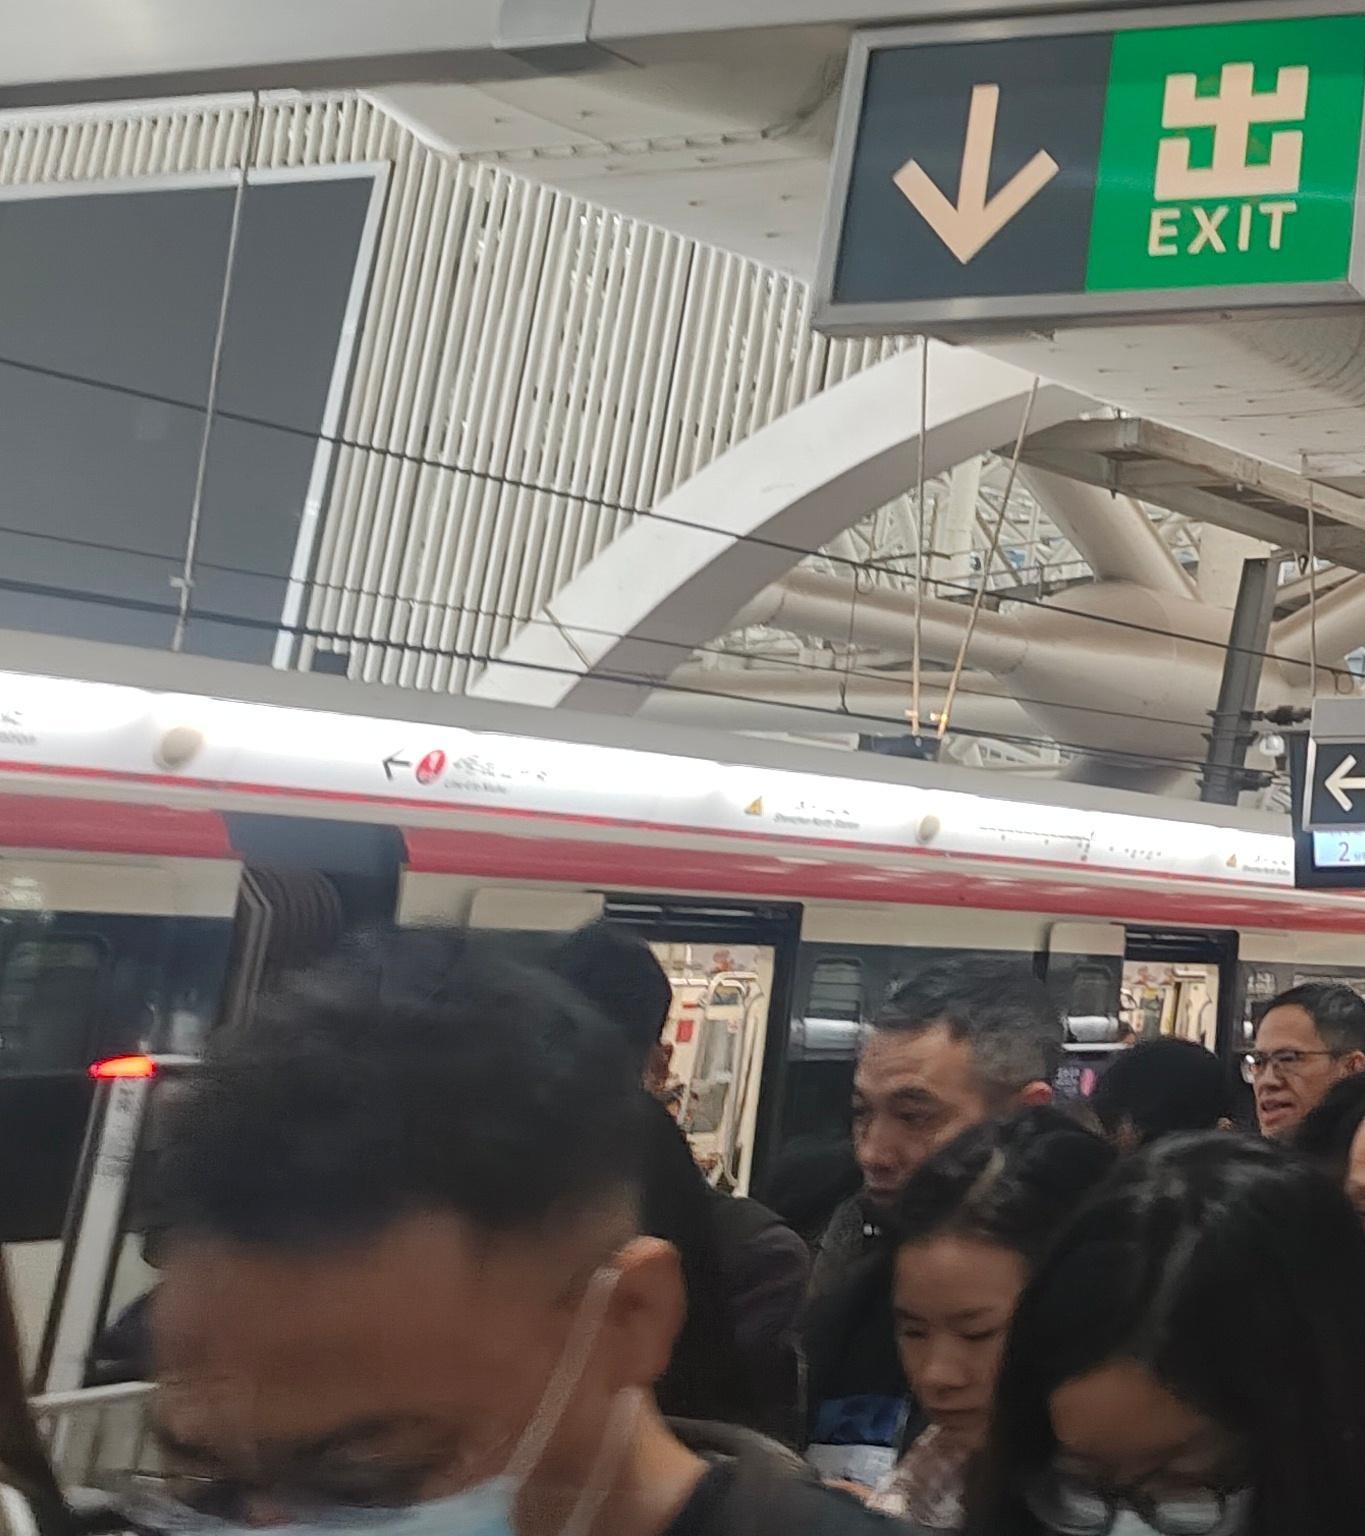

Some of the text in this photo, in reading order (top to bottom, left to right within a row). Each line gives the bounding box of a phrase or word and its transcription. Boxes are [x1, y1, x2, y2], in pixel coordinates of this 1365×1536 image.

[1154, 61, 1310, 202] 出
[1147, 200, 1298, 258] EXIT
[1338, 841, 1350, 862] 2
